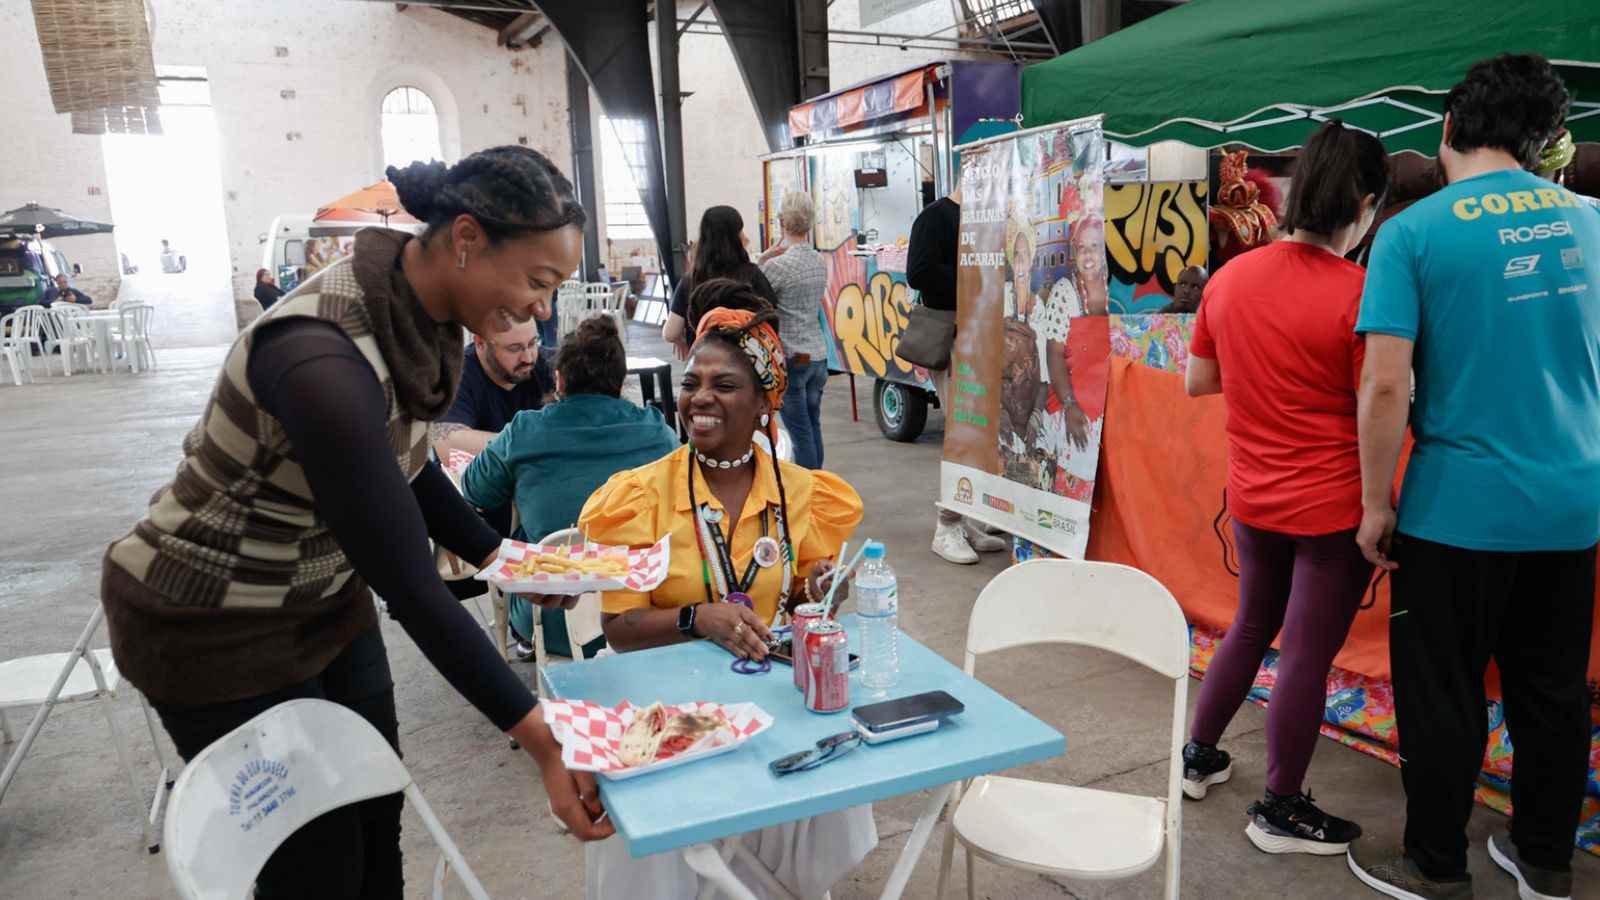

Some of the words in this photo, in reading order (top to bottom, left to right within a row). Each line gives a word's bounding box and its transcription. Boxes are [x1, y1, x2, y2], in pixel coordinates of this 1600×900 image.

[961, 231, 976, 246] DE
[1498, 220, 1573, 245] ROSSI
[959, 248, 1006, 269] ACARAJÉ
